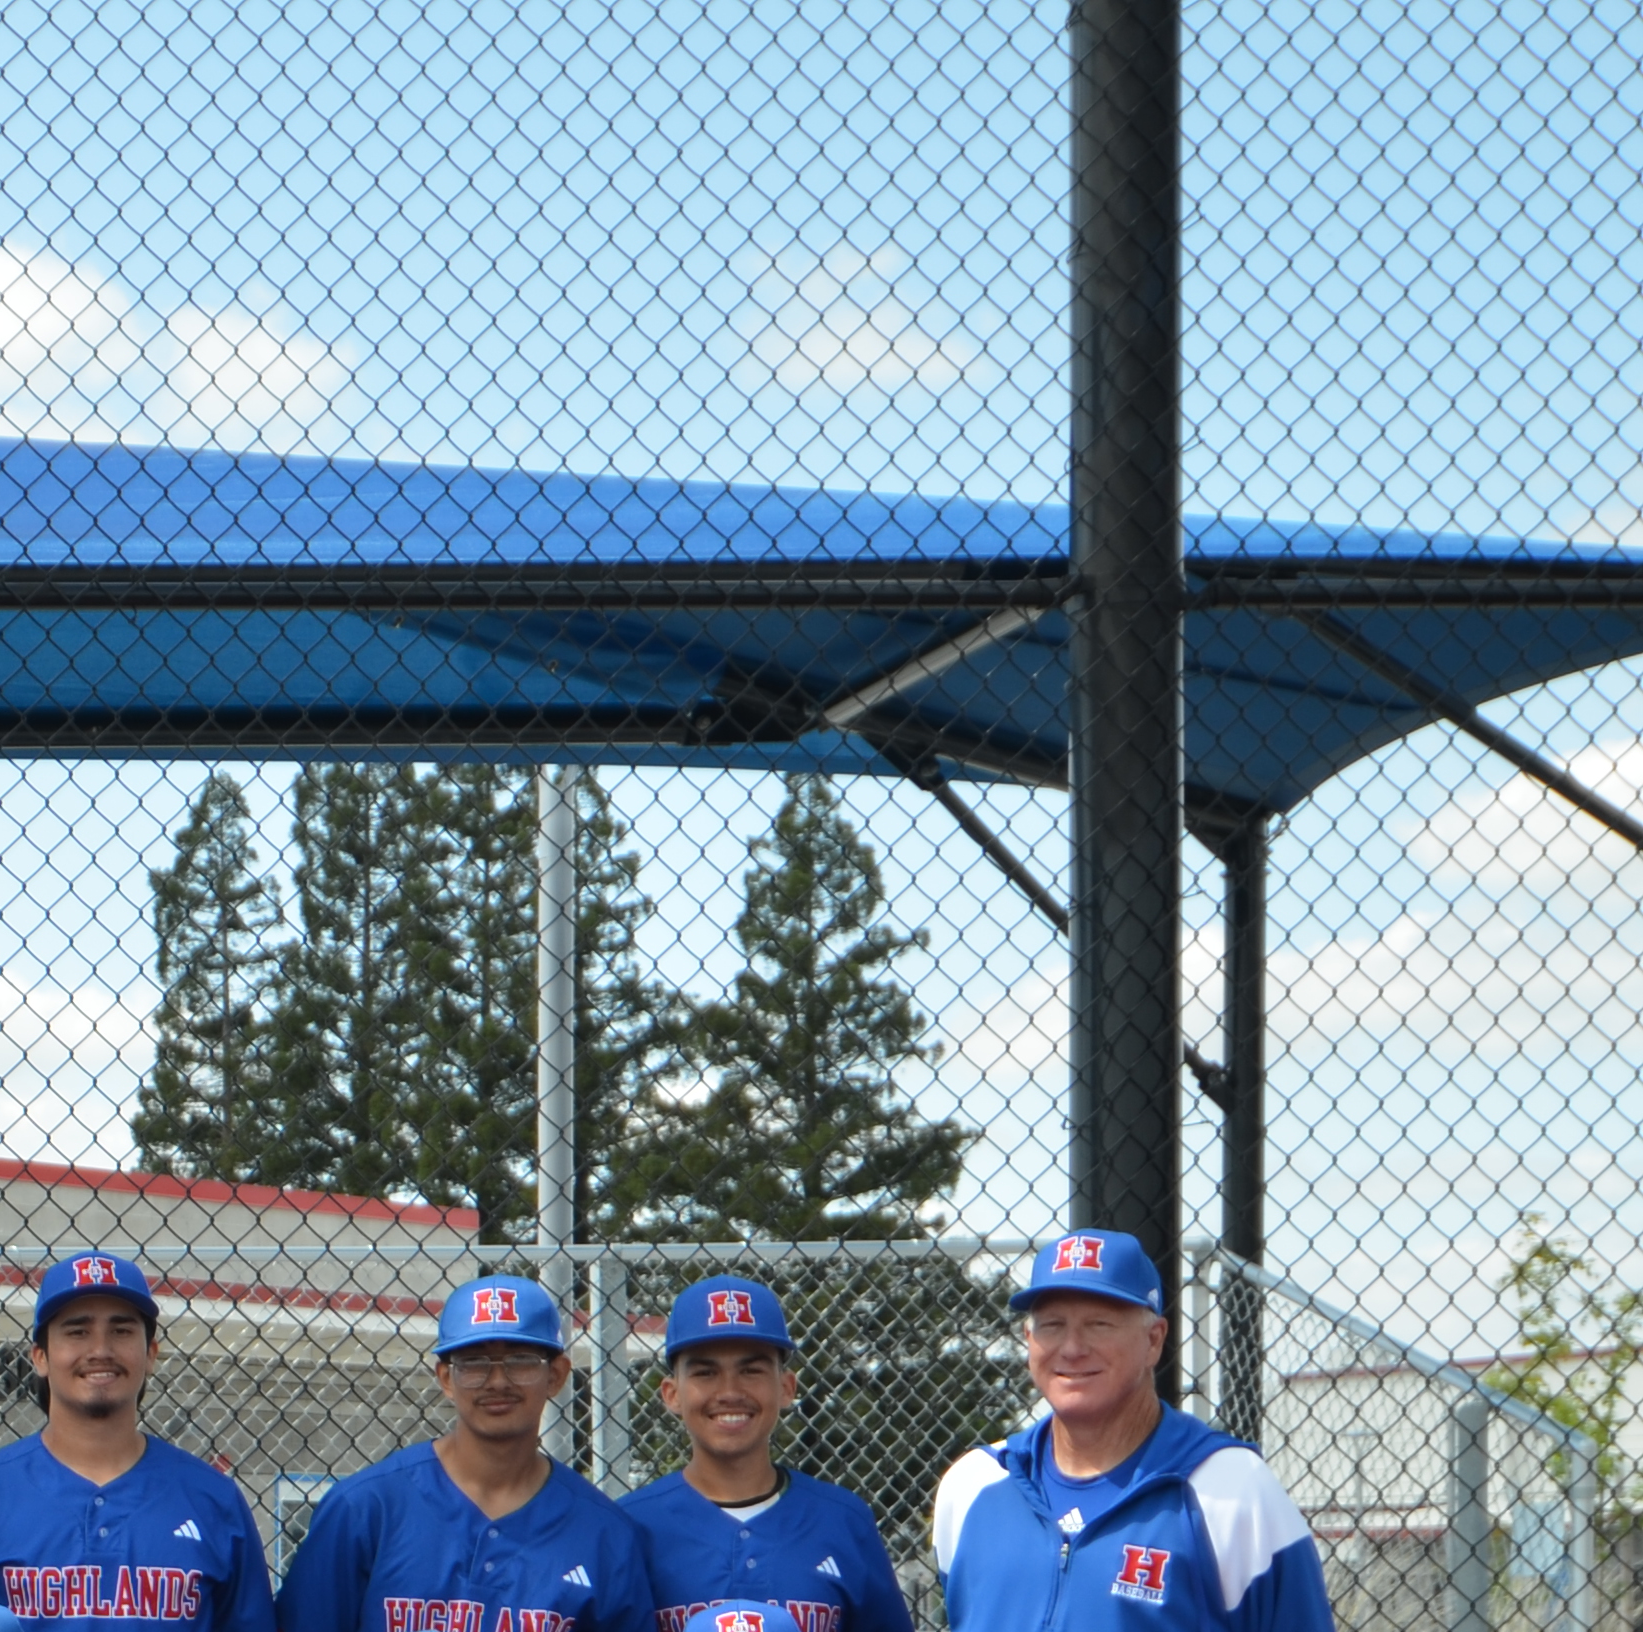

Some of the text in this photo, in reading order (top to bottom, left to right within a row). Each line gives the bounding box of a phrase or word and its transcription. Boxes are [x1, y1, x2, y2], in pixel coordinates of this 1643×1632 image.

[73, 1257, 119, 1287] H
[1052, 1235, 1105, 1273] H
[471, 1288, 519, 1324] H
[708, 1290, 756, 1326] H
[1116, 1544, 1171, 1592] H
[3, 1565, 203, 1620] HIGHLANDS
[1110, 1582, 1164, 1605] BASEBALL
